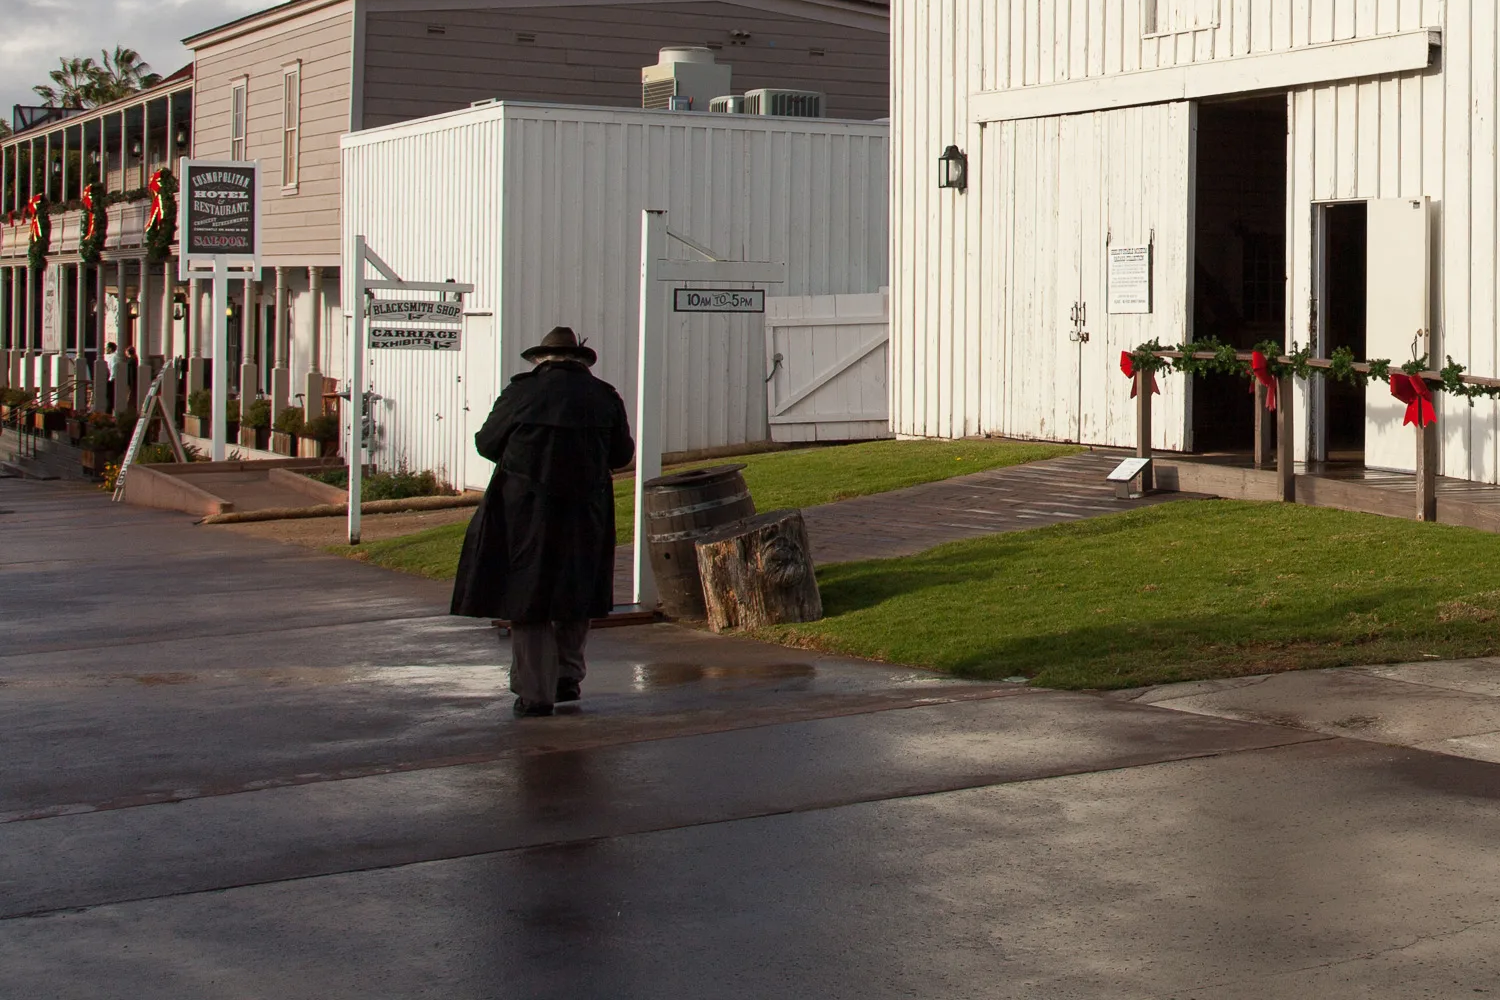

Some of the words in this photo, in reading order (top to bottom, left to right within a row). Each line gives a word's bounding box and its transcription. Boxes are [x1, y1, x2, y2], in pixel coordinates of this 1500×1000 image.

[194, 190, 248, 199] HOTEL
[713, 294, 727, 305] TO
[373, 302, 434, 315] BLACKSMITH
[372, 329, 457, 339] CARRIAGE
[371, 338, 431, 349] EXHIBITS
